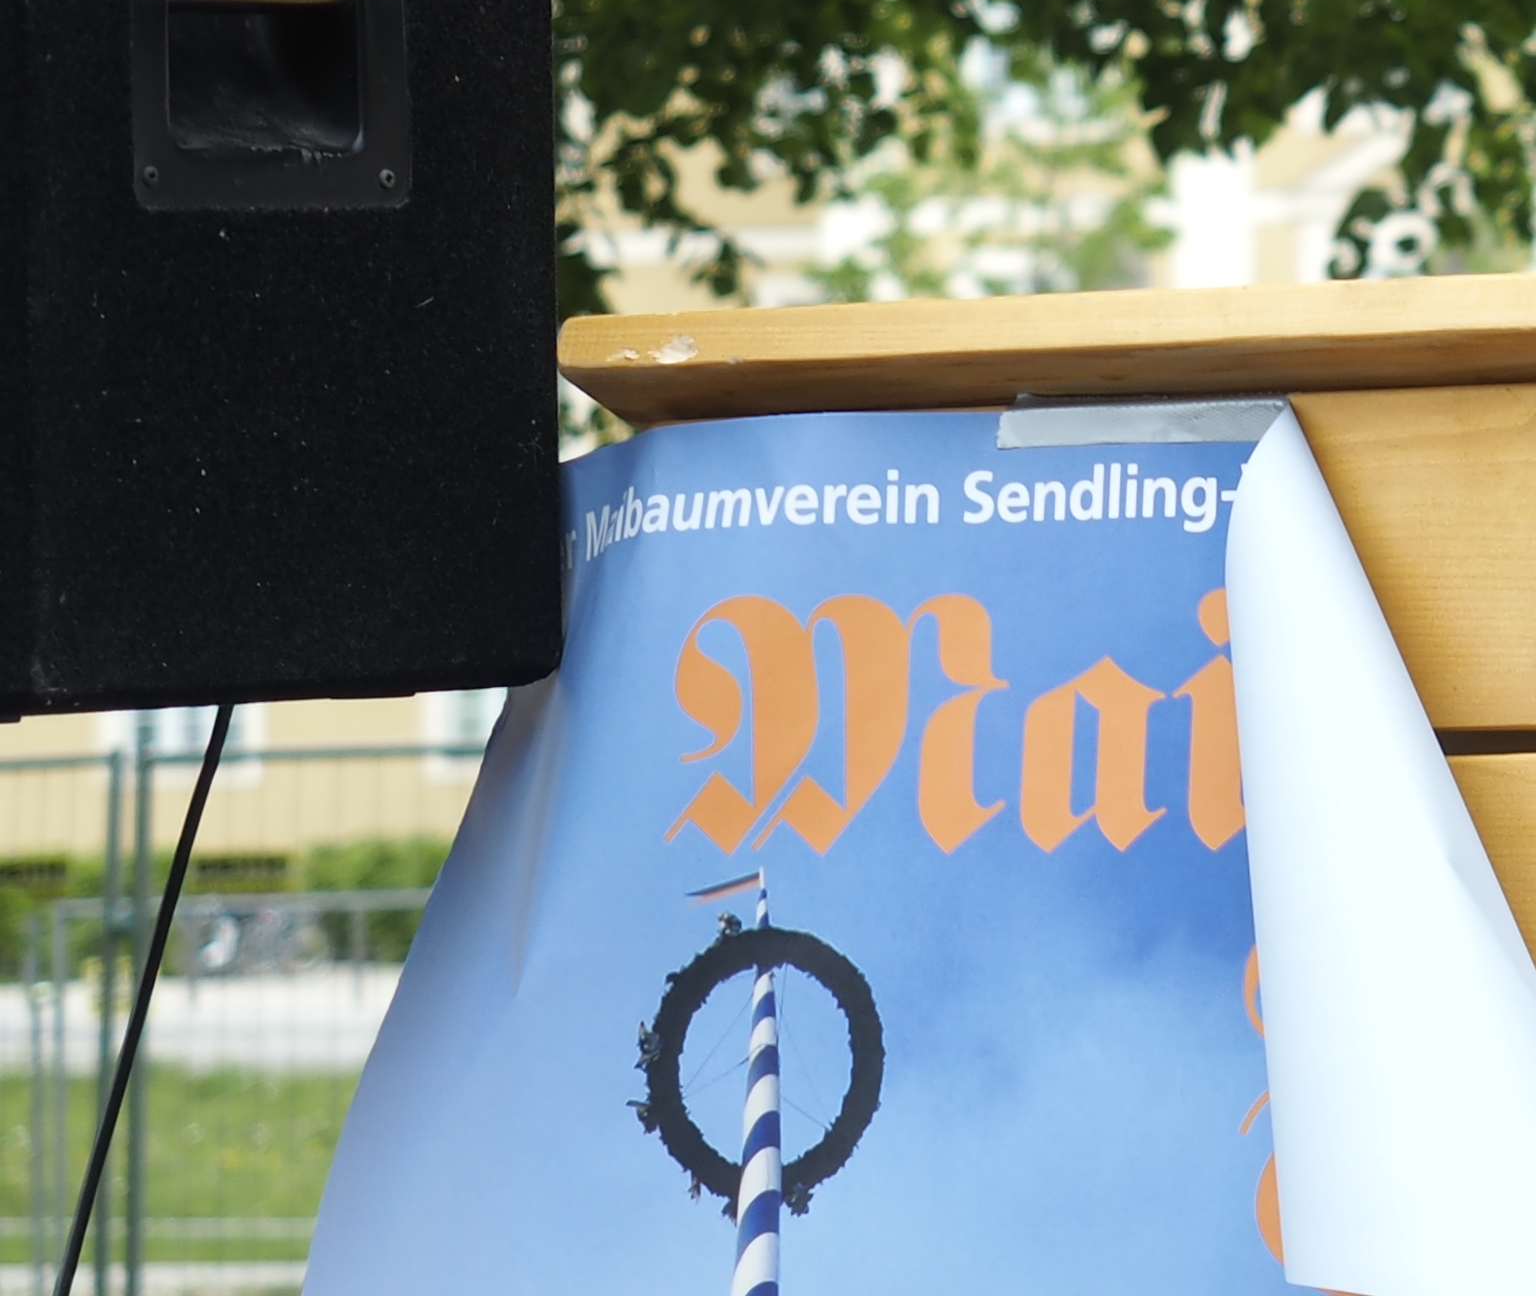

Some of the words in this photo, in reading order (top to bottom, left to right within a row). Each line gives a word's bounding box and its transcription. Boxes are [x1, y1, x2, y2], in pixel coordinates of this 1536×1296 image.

[585, 469, 940, 561] Maibaumverein
[963, 462, 1249, 533] Sendling-
[664, 587, 1246, 855] Mai
